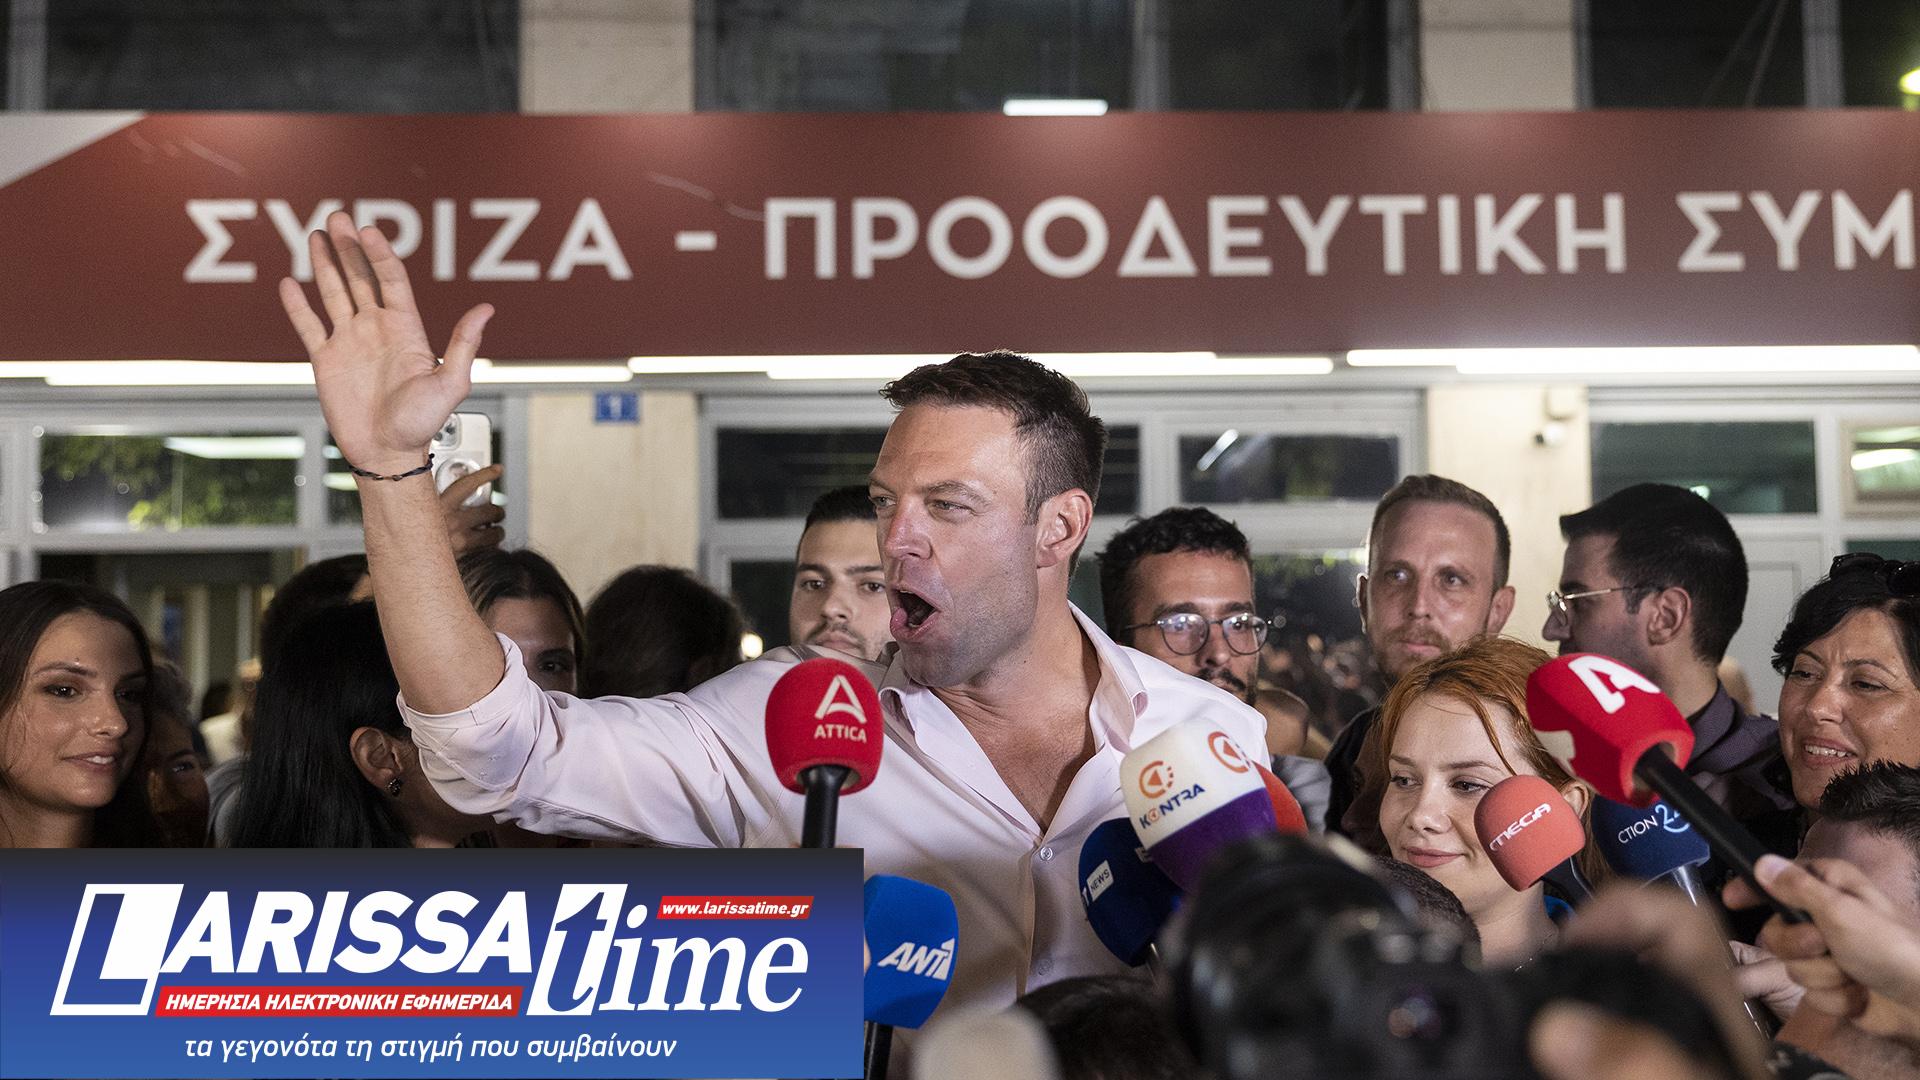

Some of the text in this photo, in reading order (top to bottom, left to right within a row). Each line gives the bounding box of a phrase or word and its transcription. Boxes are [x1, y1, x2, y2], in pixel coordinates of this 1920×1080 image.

[184, 188, 1916, 283] ΣΥΡΙΖΑ - ΠΡΟΟΔΕΥΤΙΚΗ ΣΥΜ
[814, 723, 867, 744] ATTICA
[1139, 783, 1206, 829] KONTRA
[1489, 803, 1552, 851] MEGA
[1090, 869, 1111, 892] NEWS
